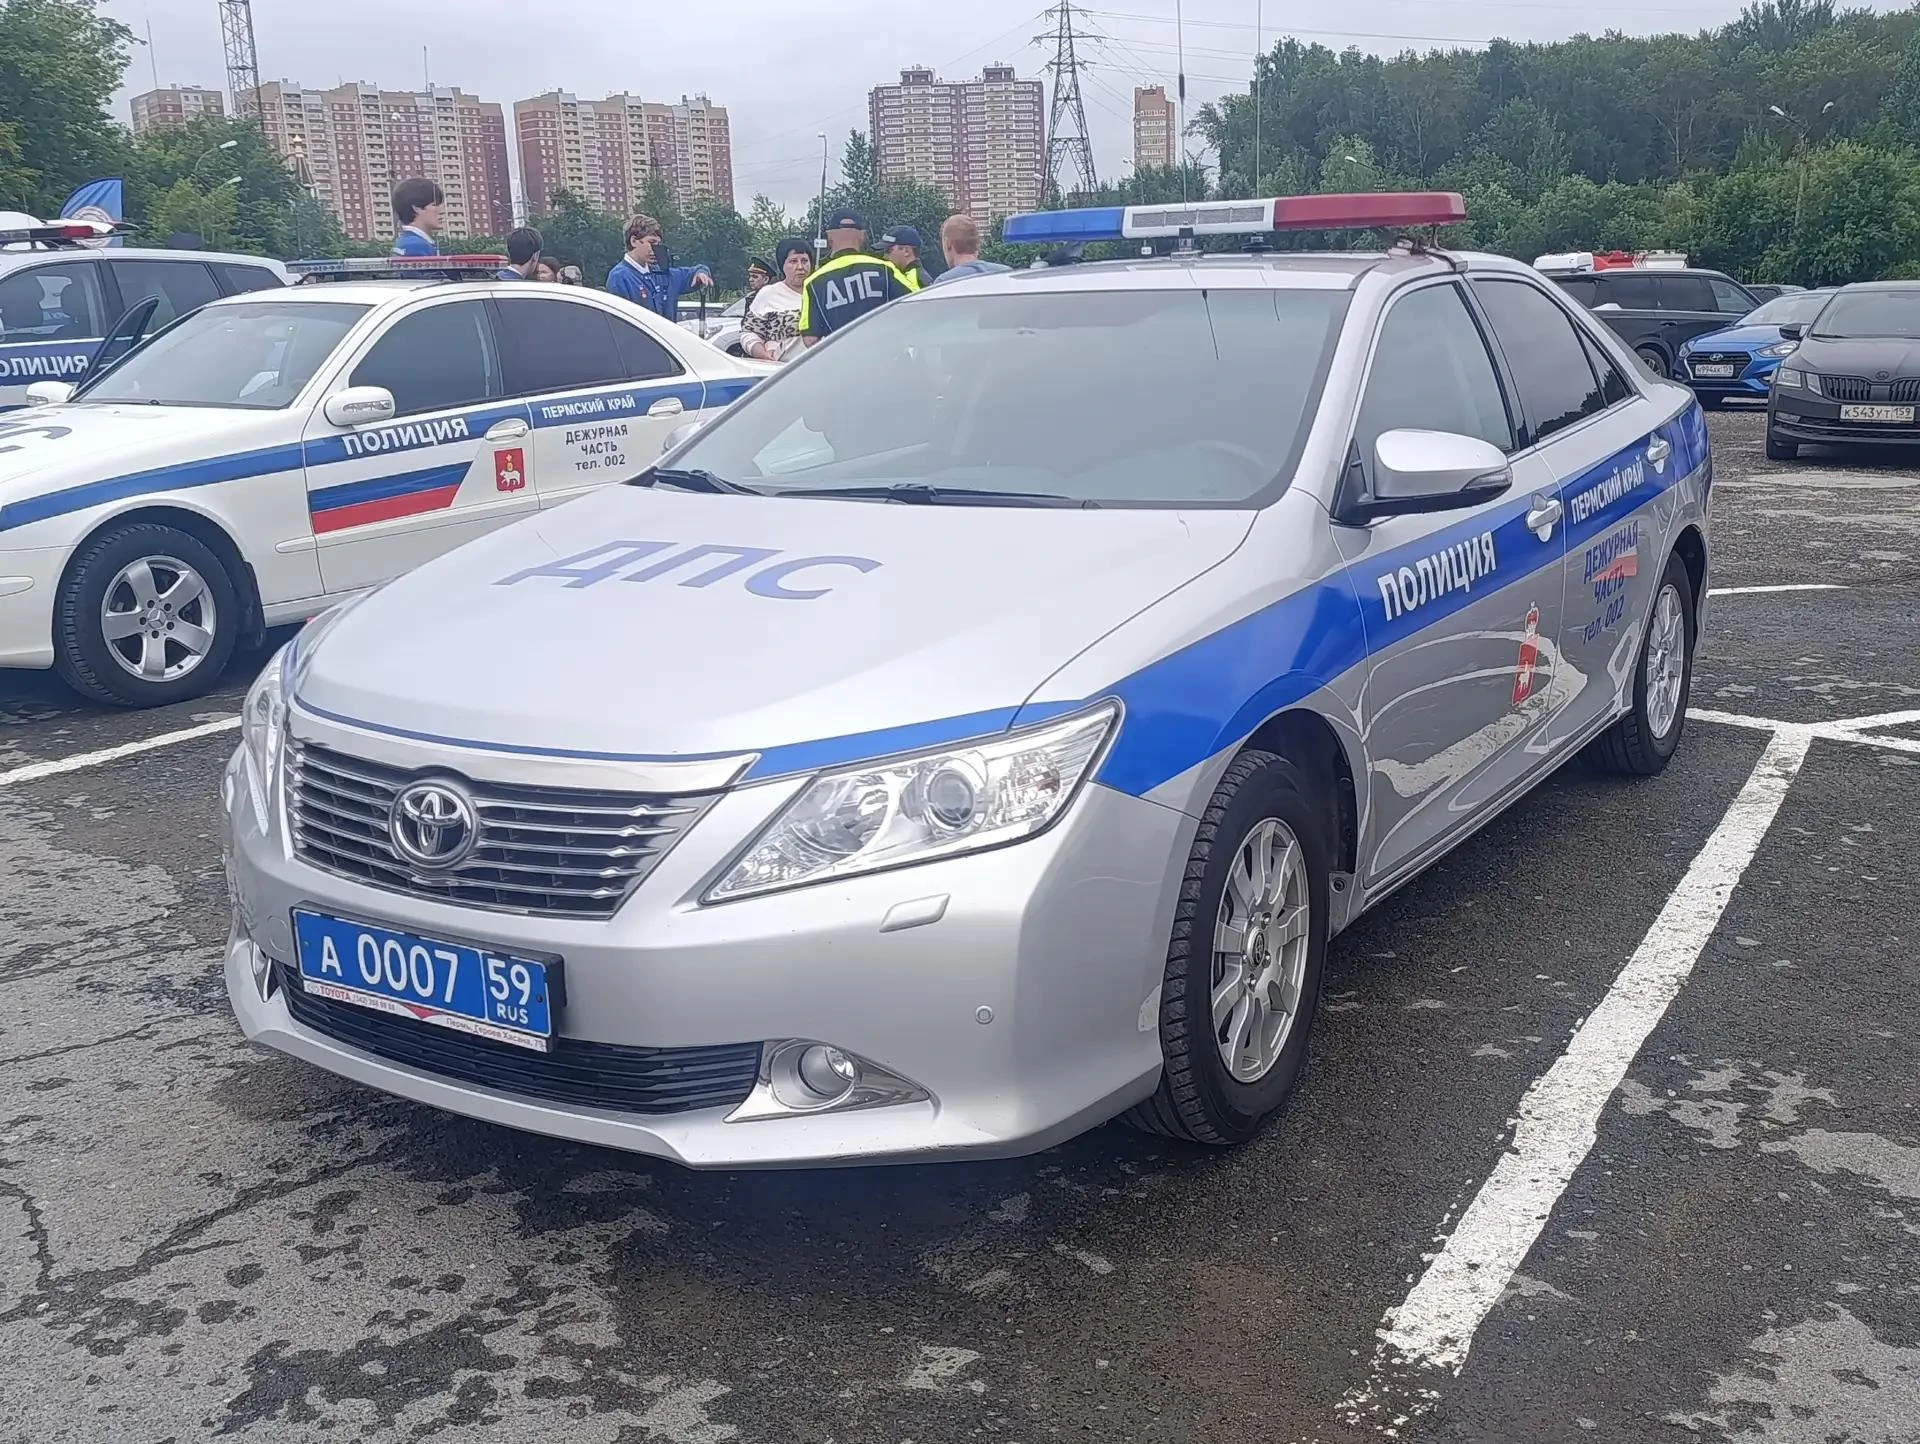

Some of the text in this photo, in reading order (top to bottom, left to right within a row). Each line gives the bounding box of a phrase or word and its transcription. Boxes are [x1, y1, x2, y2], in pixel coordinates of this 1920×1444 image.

[825, 271, 883, 310] ДПС
[0, 355, 89, 378] ОЛИЦИЯ
[542, 395, 636, 419] ПЕРМСКИЙ КРАЙ
[1844, 406, 1911, 418] К543УТ 159
[341, 417, 469, 456] ПОЛИЦИЯ
[566, 424, 628, 445] ДЕЖУРНАЯ
[581, 441, 618, 456] ЧАСТЬ
[575, 454, 626, 471] тел. 002
[1570, 454, 1645, 525] ПЕРМСКИЙ КРАЙ
[490, 539, 885, 600] ДПС
[1583, 520, 1639, 584] ДЕЖУРНАЯ
[1377, 530, 1497, 622] ПОЛИЦИЯ
[1594, 564, 1625, 605] ЧАСТЬ
[1604, 594, 1625, 629] 002
[321, 933, 458, 1003] А 0007
[488, 957, 531, 1006] 59
[319, 985, 352, 1001] TOYOTA
[496, 1002, 529, 1025] RUS
